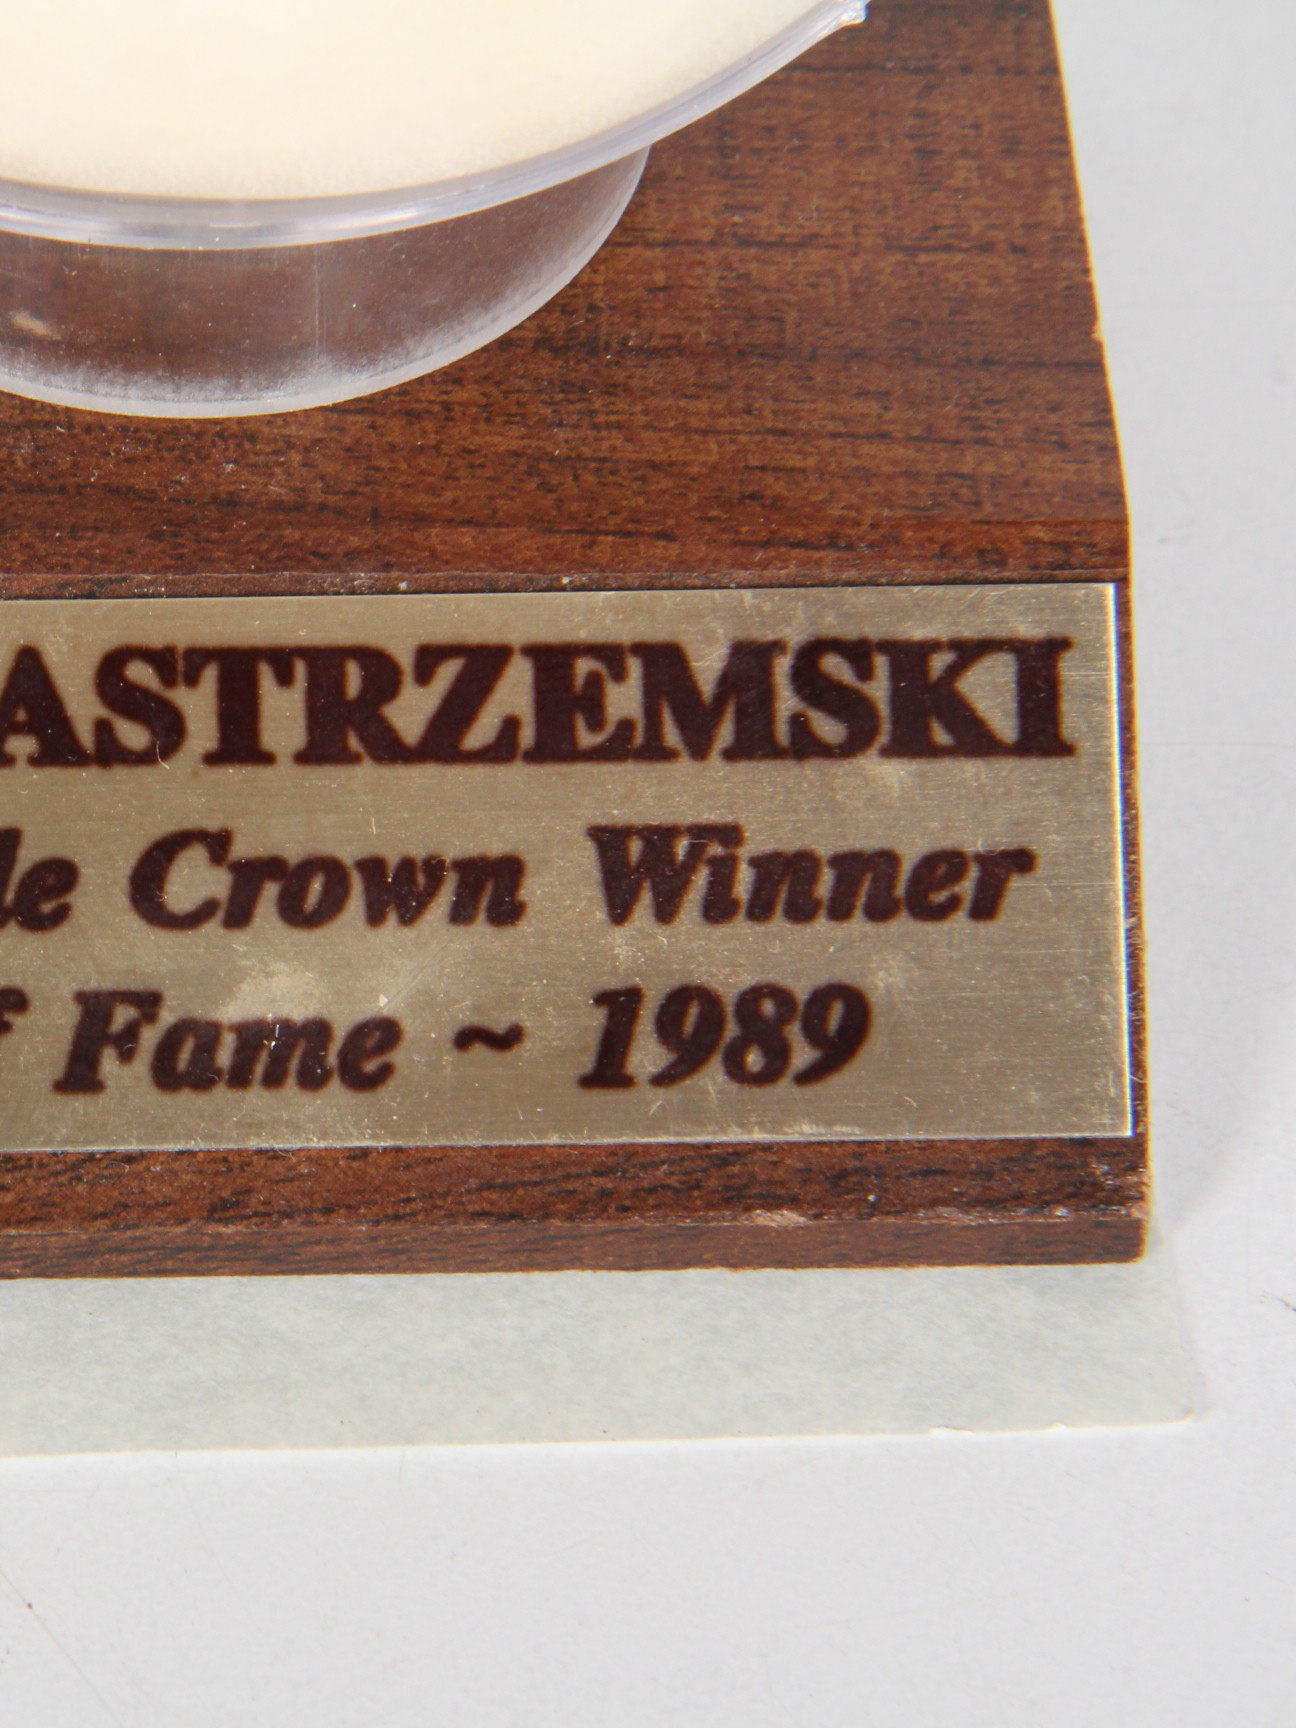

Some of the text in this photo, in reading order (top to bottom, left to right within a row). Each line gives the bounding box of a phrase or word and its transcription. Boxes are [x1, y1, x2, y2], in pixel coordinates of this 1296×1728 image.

[130, 829, 525, 928] Crown
[588, 825, 1035, 923] Winner
[54, 991, 399, 1092] Fame
[580, 984, 869, 1088] 1989
